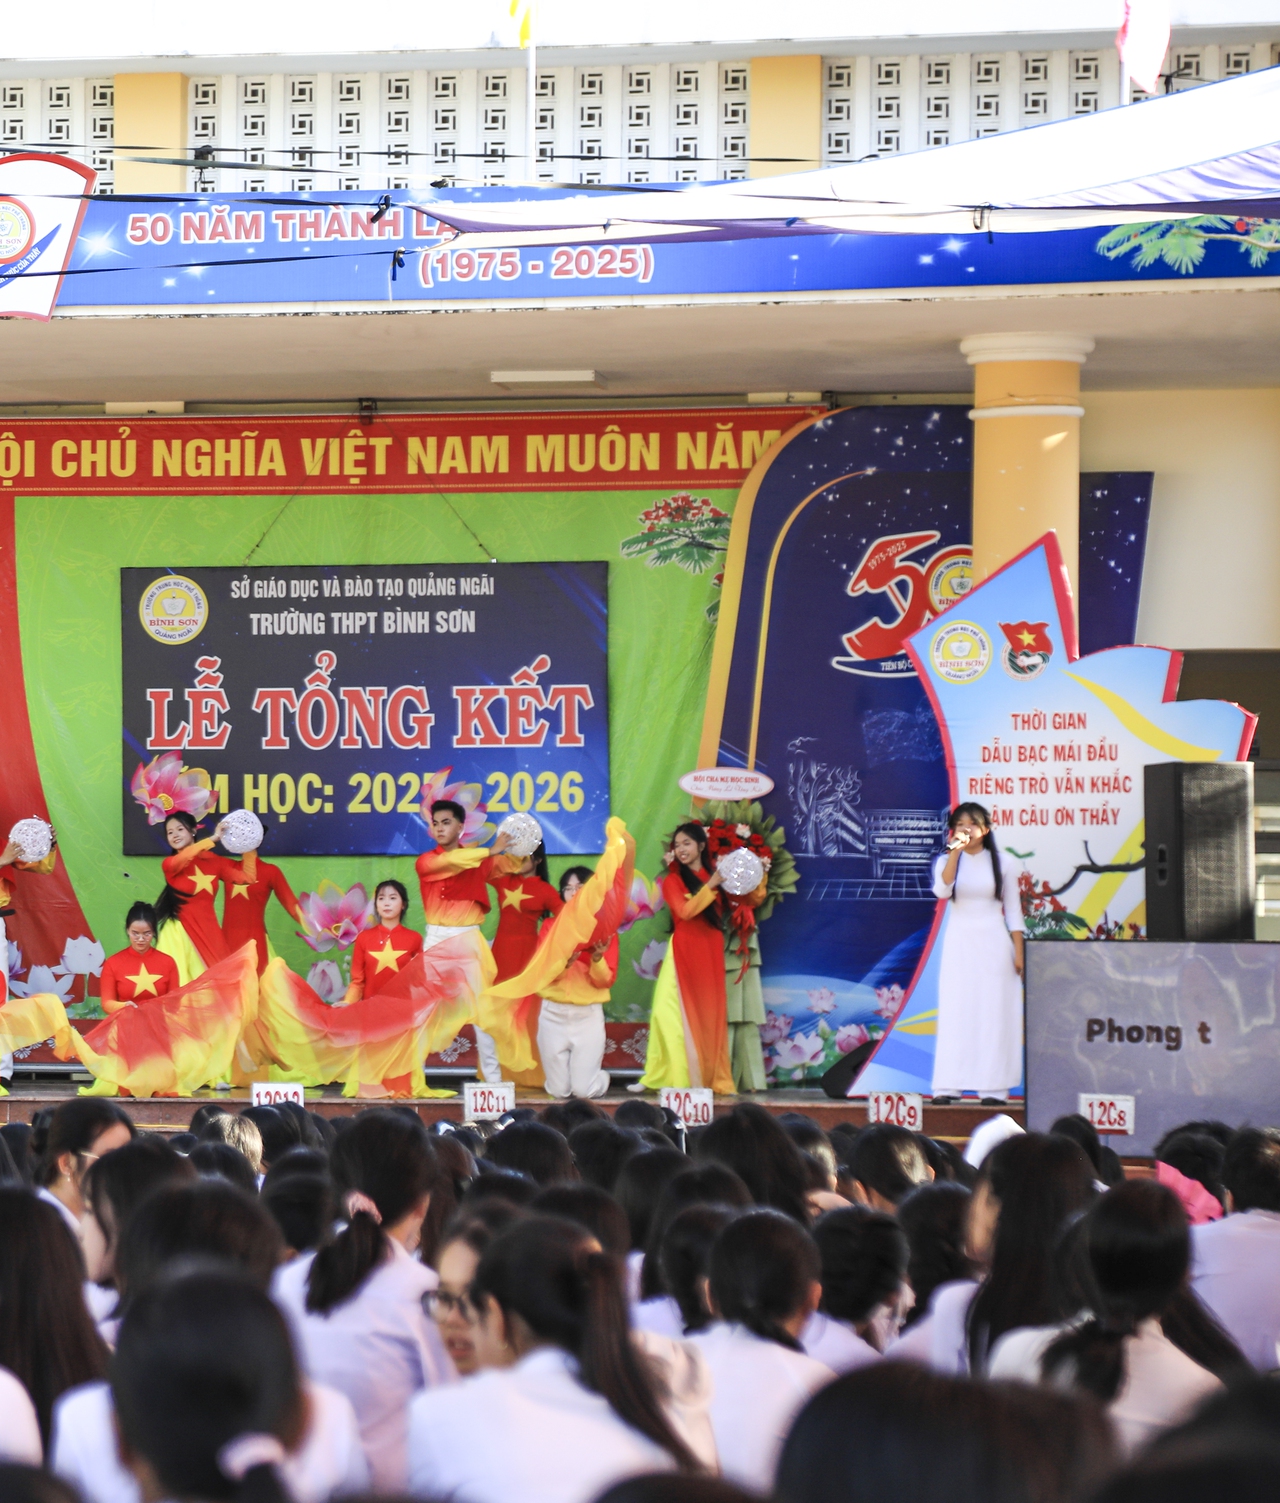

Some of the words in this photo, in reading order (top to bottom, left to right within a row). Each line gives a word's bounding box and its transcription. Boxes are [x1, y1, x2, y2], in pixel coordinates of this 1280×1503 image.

[128, 213, 171, 245] 50
[181, 206, 264, 243] NĂM
[275, 204, 403, 242] THÀNH
[419, 248, 521, 288] (1975
[552, 246, 654, 284] 2025)
[51, 427, 137, 478] CHỦ
[152, 430, 287, 477] NGHĨA
[300, 429, 393, 484] VIỆT
[407, 435, 509, 475] NAM
[525, 425, 660, 473] MUÔN
[676, 423, 782, 470] NĂM
[231, 574, 250, 599] SỞ
[254, 576, 286, 599] GIÁO
[290, 579, 319, 601] DỤC
[323, 575, 341, 597] VÀ
[344, 575, 372, 598] ĐÀO
[377, 578, 403, 600] TẠO
[408, 572, 456, 598] QUẢNG
[460, 573, 495, 595] NGÃI
[149, 617, 174, 626] BÌNH
[178, 617, 198, 626] SƠN
[250, 607, 325, 635] TRƯỜNG
[331, 612, 377, 634] THPT
[383, 606, 429, 634] BÌNH
[435, 609, 476, 634] SƠN
[147, 655, 232, 751] LỄ
[252, 650, 435, 750] TỔNG
[453, 654, 595, 749] KẾT
[1011, 708, 1046, 730] THỜI
[1052, 713, 1087, 730] GIAN
[981, 737, 1012, 763] DẪU
[1018, 744, 1048, 766] BẠC
[1054, 740, 1081, 761] MÁI
[969, 772, 1014, 795] RIÊNG
[1019, 772, 1049, 794] TRÒ
[1054, 767, 1085, 793] VẪN
[1090, 767, 1132, 793] KHẮC
[243, 772, 334, 823] HỌC:
[484, 771, 585, 813] 2026
[1019, 804, 1049, 826] CÂU
[1054, 806, 1075, 826] ƠN
[1080, 800, 1120, 826] THẦY
[1086, 1018, 1182, 1051] Phong
[473, 1090, 507, 1113] 12C11
[874, 1095, 918, 1127] 12C9
[1089, 1101, 1127, 1127] 12C8
